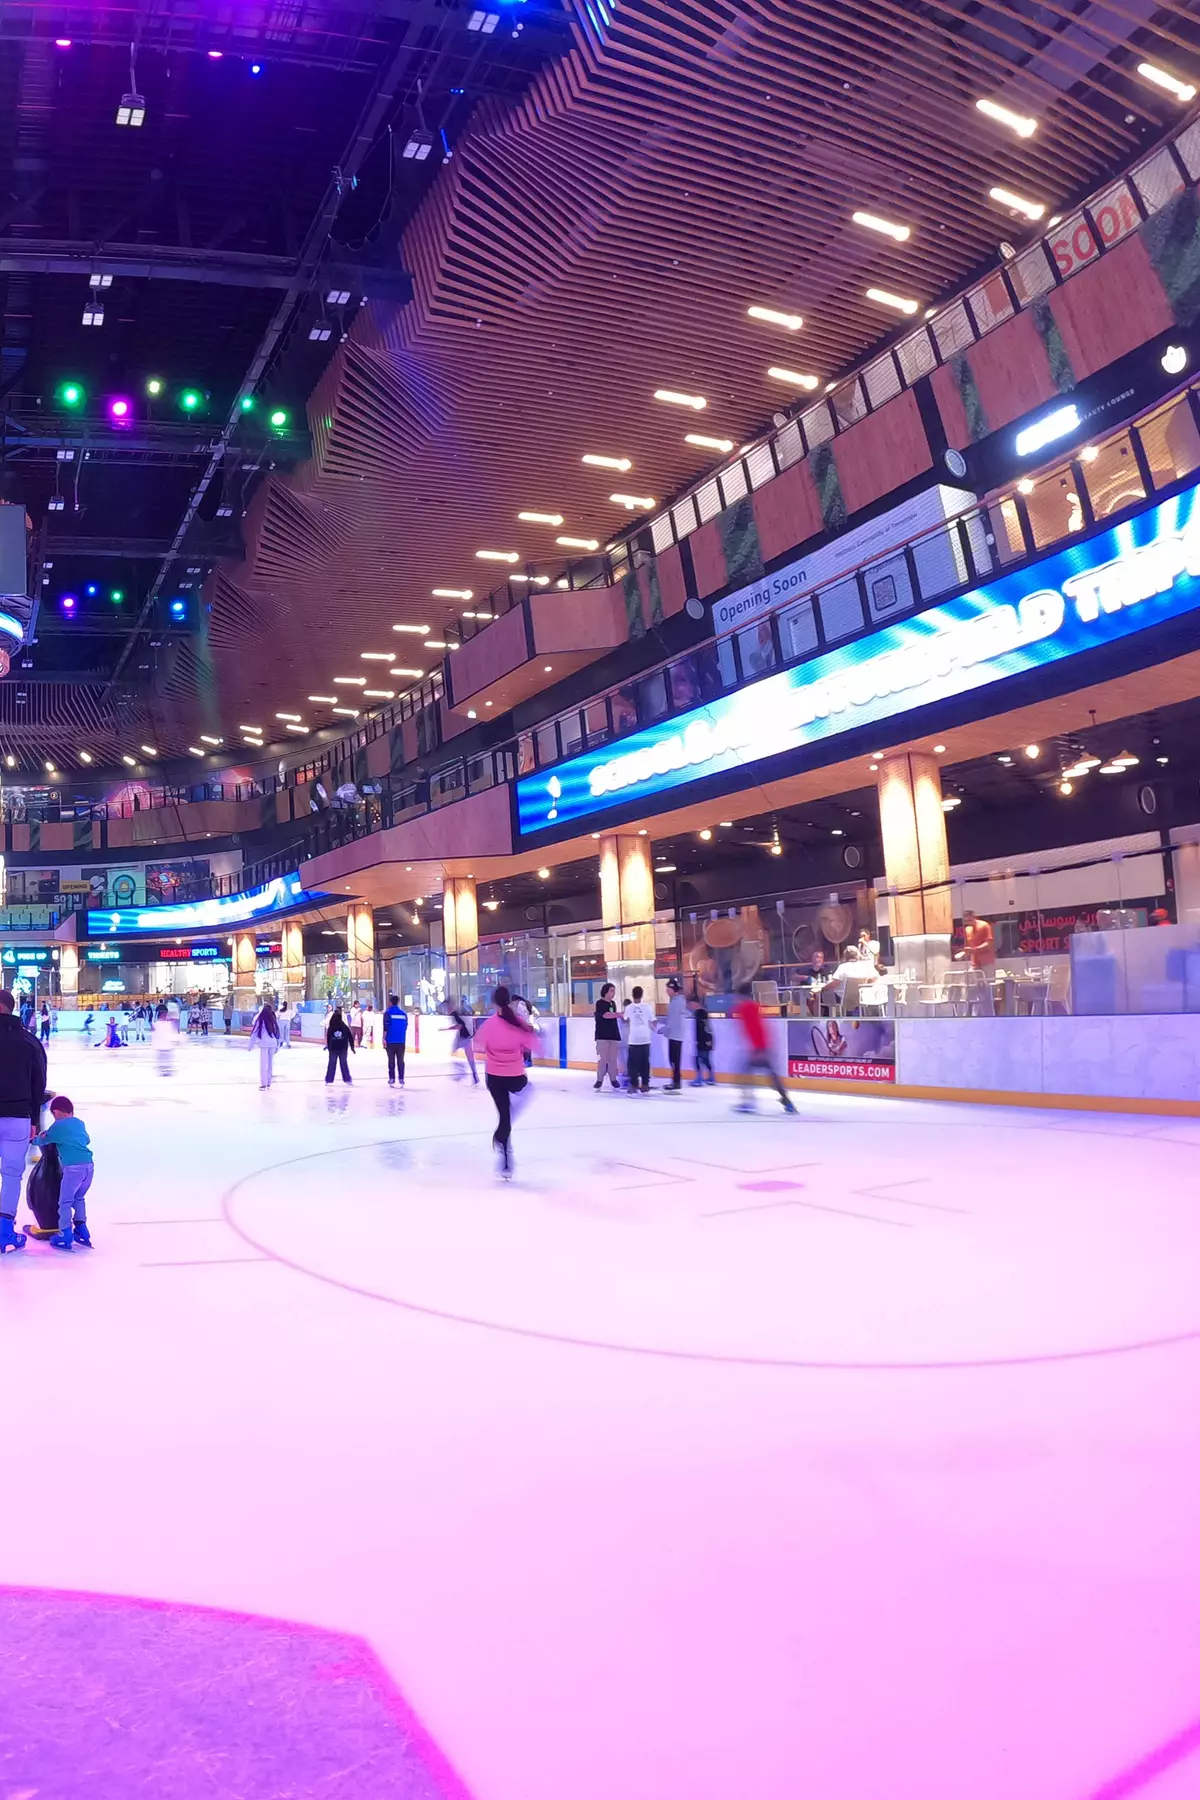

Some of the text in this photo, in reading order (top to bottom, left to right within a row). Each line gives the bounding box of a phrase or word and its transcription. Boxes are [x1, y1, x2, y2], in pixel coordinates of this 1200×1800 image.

[719, 570, 808, 623] Opening Soon
[160, 948, 218, 958] HEALTHY SPORTS
[792, 1062, 890, 1078] LEADERSPORTS.COM
